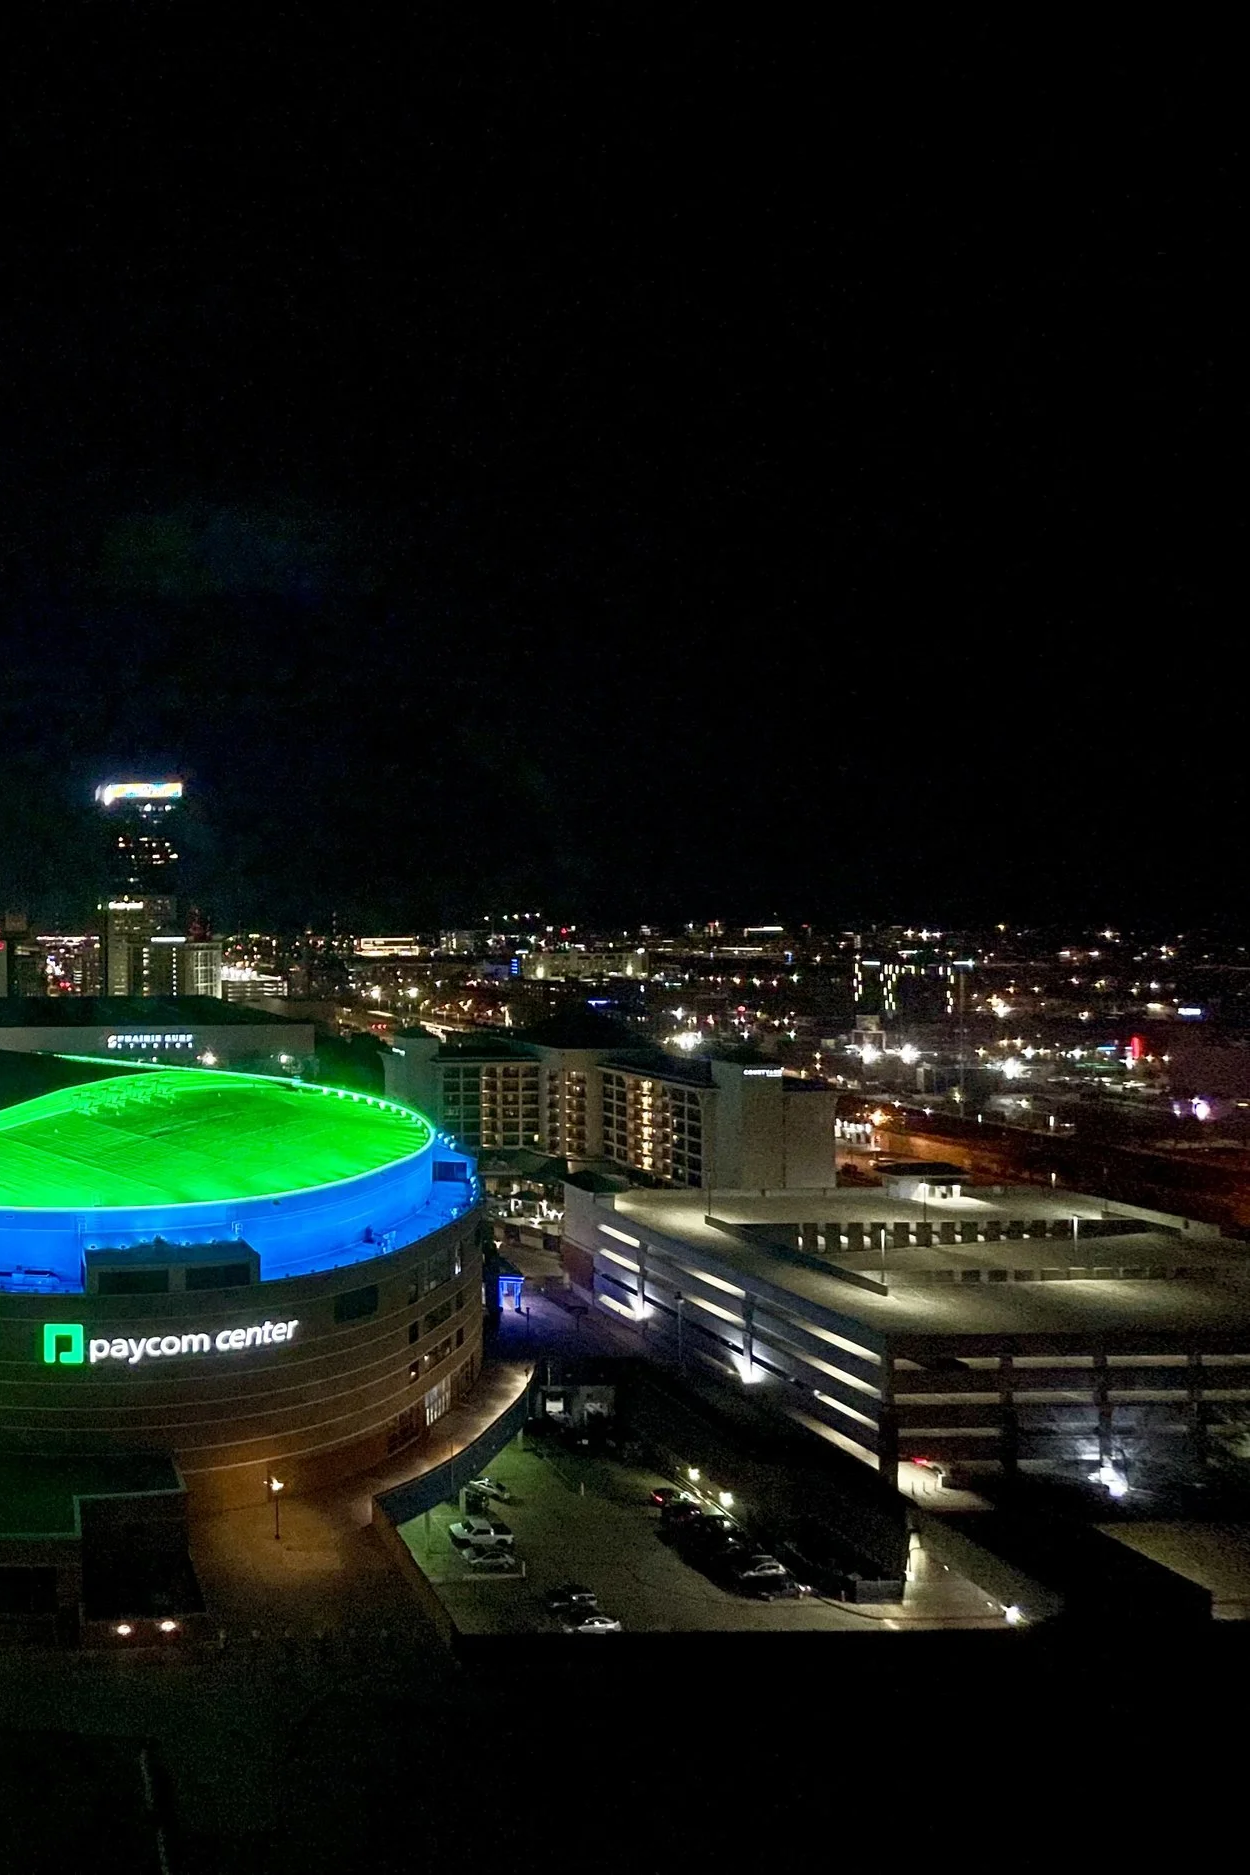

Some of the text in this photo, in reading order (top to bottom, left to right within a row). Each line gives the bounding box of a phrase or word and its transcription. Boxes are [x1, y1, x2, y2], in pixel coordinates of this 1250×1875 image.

[117, 1034, 193, 1043] PRAIRIE SURF
[89, 1319, 299, 1364] paycom center
